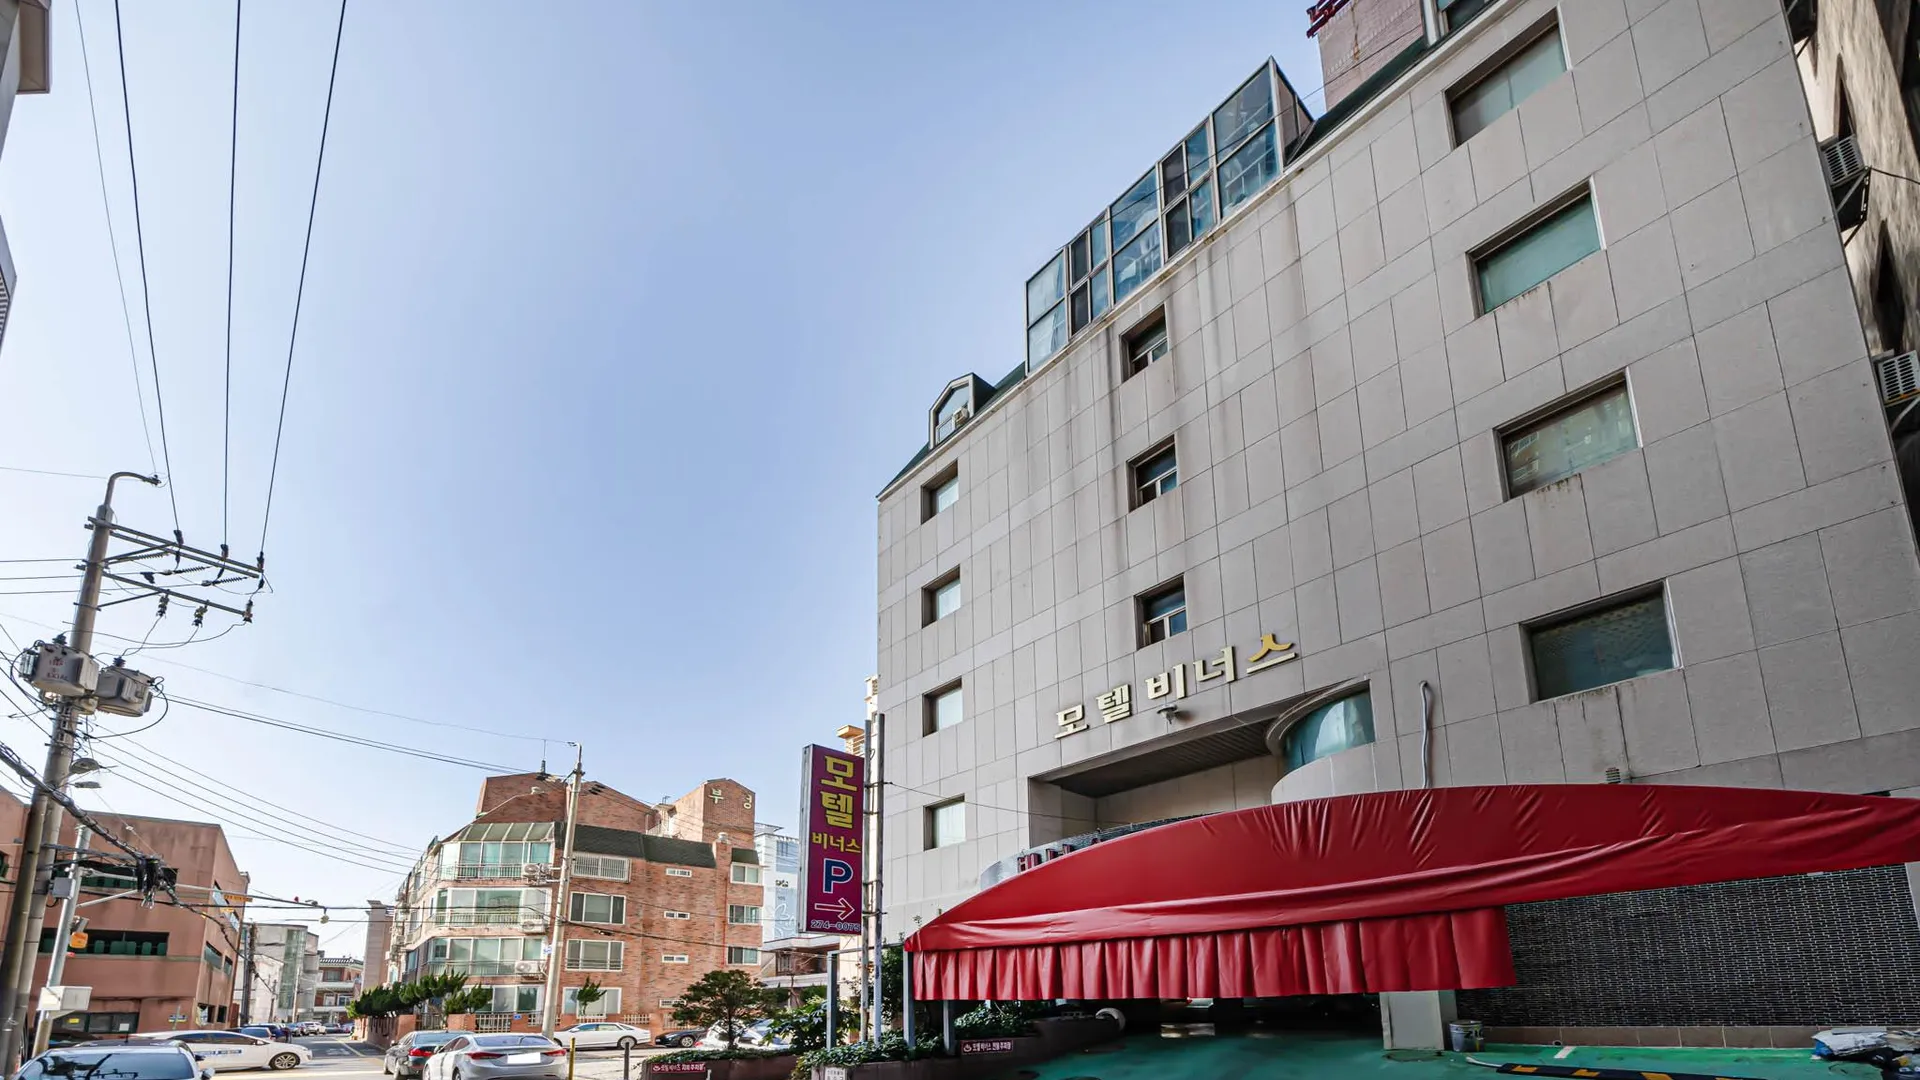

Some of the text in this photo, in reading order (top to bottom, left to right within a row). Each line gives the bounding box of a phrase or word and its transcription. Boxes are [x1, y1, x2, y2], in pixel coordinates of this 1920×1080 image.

[1055, 633, 1298, 739] 모텔 비너스
[820, 755, 858, 829] 모텔
[811, 832, 861, 853] 비너스
[822, 858, 854, 893] P
